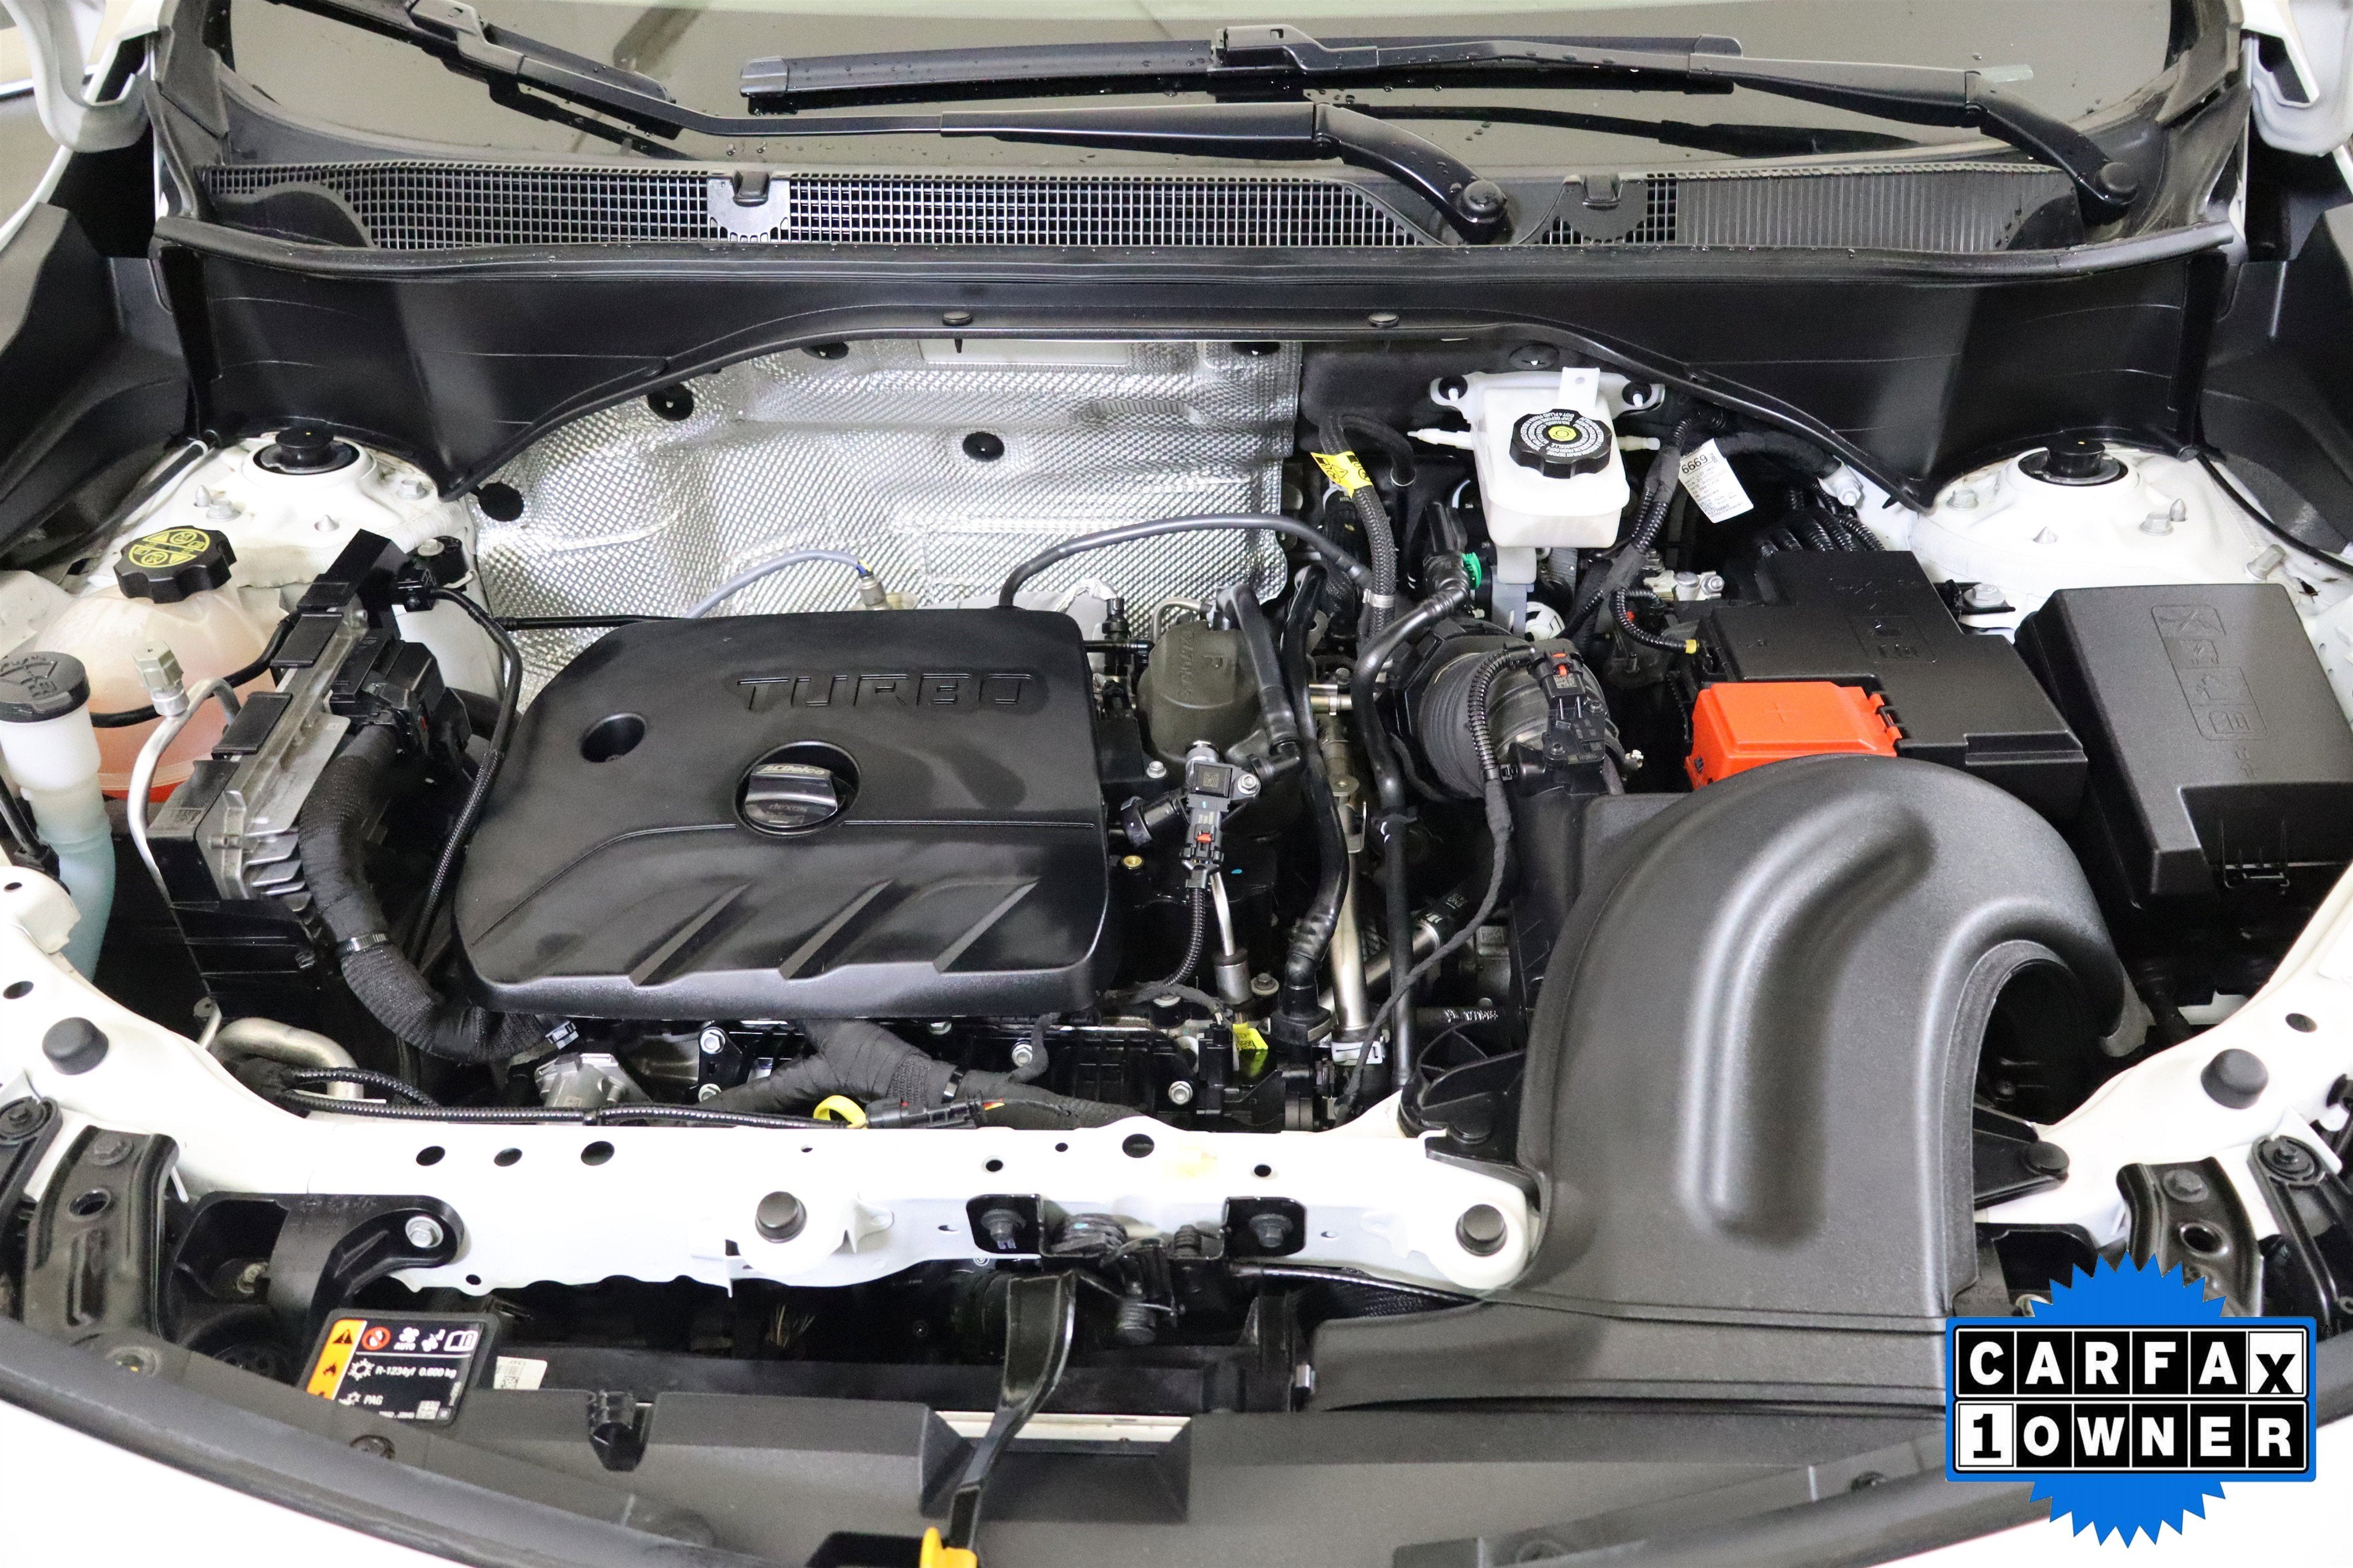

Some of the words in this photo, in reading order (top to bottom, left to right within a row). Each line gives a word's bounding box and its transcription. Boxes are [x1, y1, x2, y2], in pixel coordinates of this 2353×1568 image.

[1681, 454, 1708, 474] 6669
[738, 673, 1034, 710] TURBO
[761, 765, 826, 775] ACDelco
[394, 1342, 416, 1351] AUTO
[375, 1365, 416, 1378] R-1234yf
[418, 1366, 444, 1377] 0.600
[445, 1366, 457, 1379] kg
[363, 1395, 384, 1405] PAG
